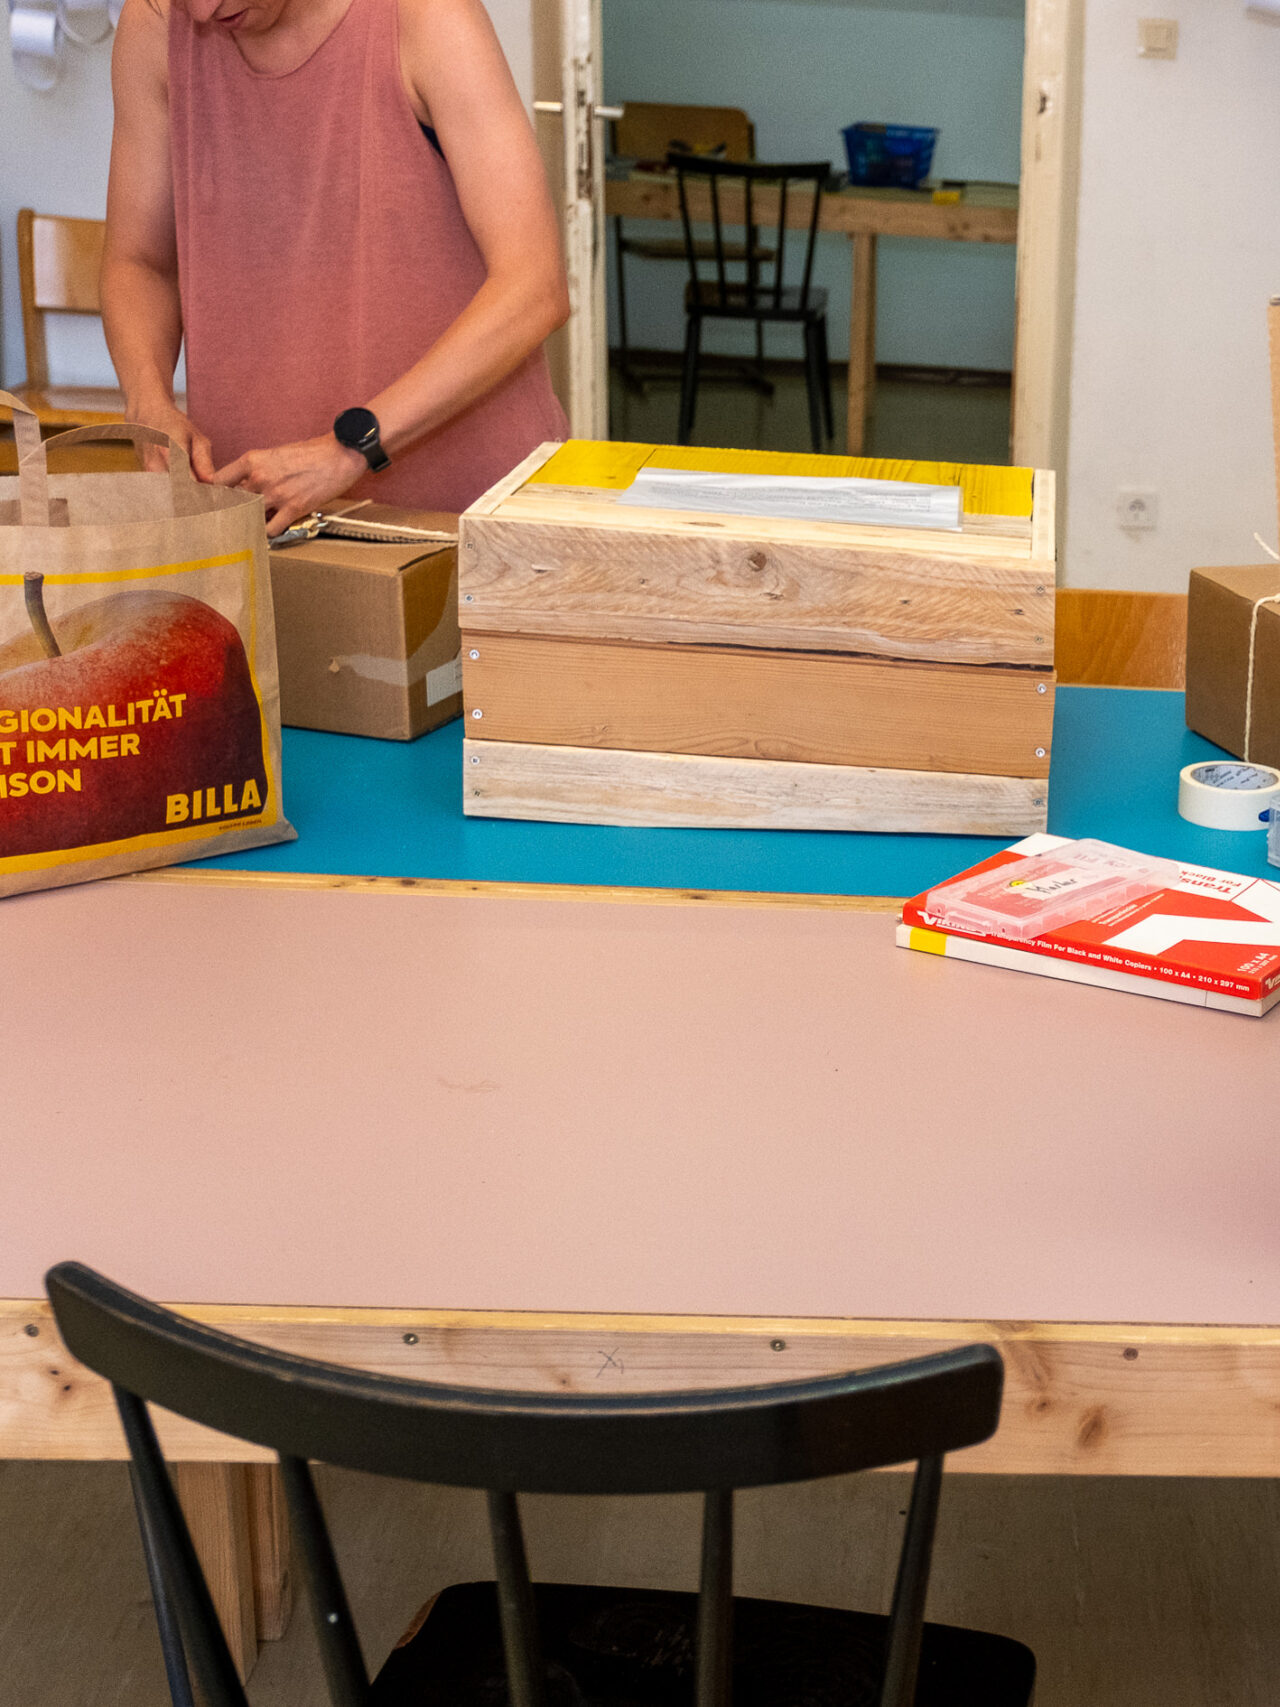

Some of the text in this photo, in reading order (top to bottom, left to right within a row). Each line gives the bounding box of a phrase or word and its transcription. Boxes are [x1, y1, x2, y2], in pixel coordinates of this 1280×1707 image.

[0, 688, 187, 734] GIONALITÄT
[26, 733, 140, 764] IMMER
[165, 778, 262, 824] BILLA
[1037, 940, 1052, 950] Film
[1053, 943, 1066, 952] For
[1067, 946, 1086, 957] Black
[1088, 952, 1102, 960] and
[1103, 954, 1123, 965] White
[1124, 959, 1152, 971] Copiers
[1160, 967, 1173, 976] 100
[1180, 971, 1191, 979] A4
[1198, 975, 1213, 984] 210
[1220, 980, 1235, 988] 297
[1235, 984, 1250, 992] mm
